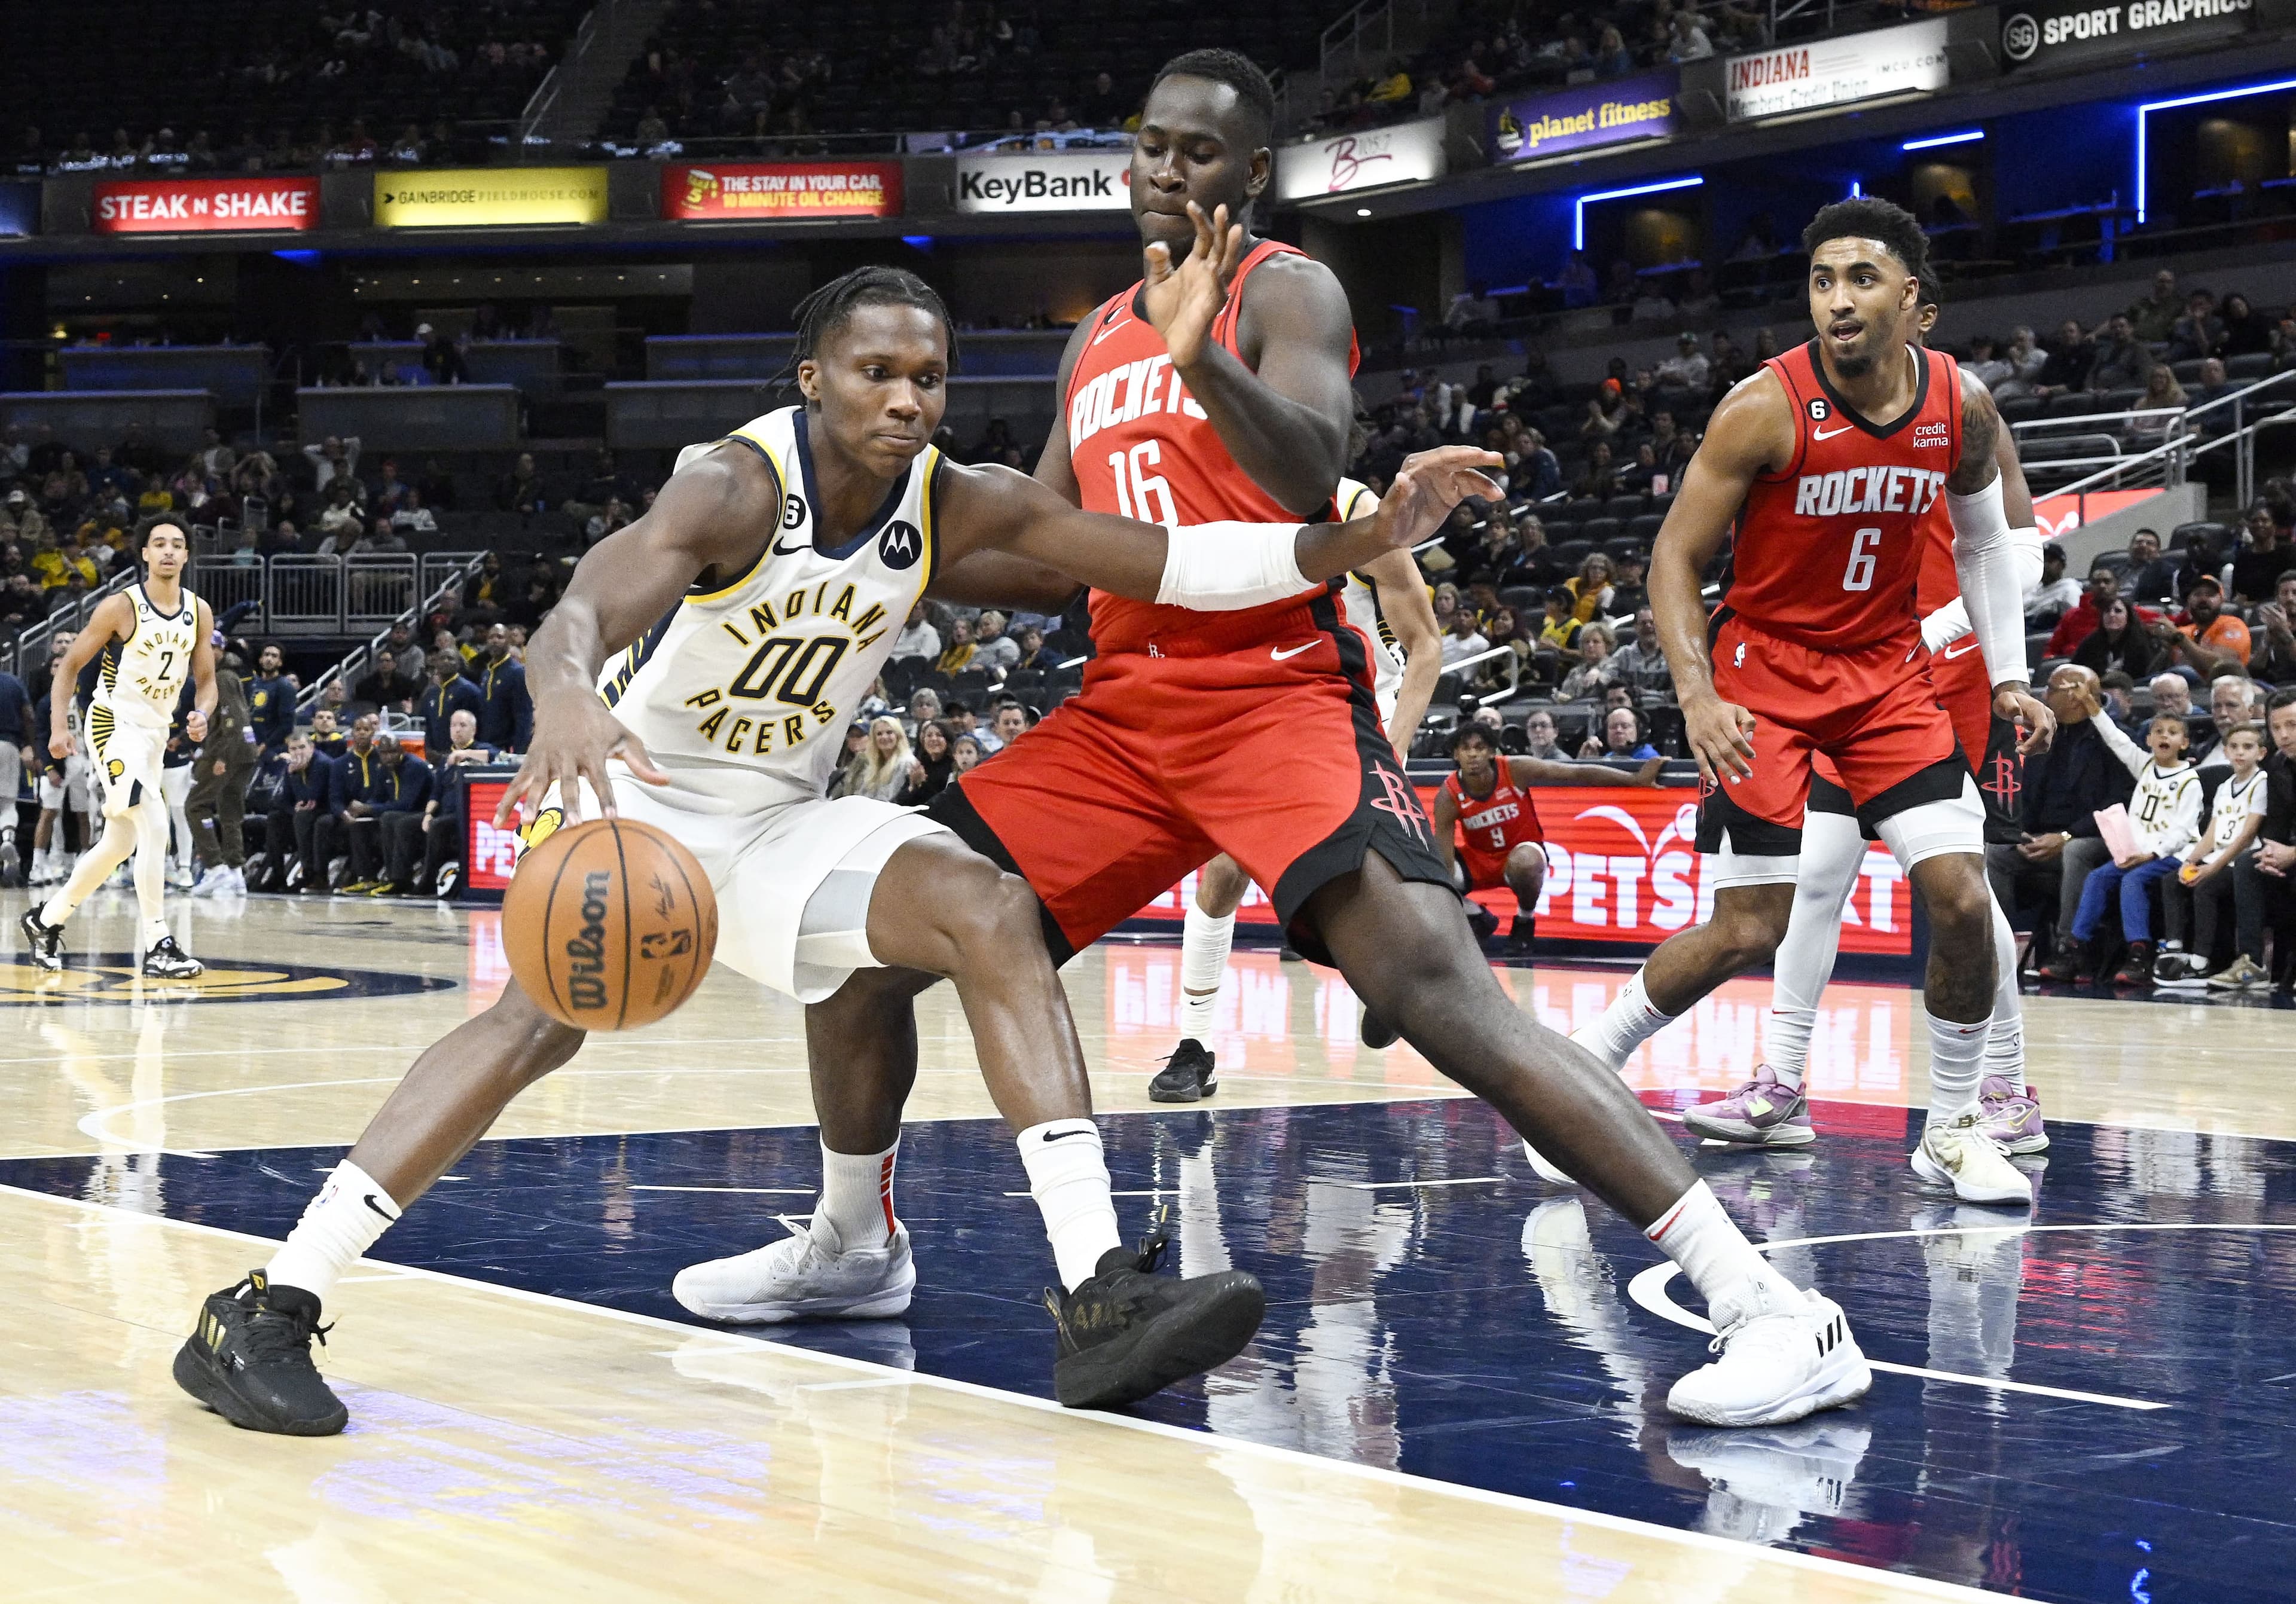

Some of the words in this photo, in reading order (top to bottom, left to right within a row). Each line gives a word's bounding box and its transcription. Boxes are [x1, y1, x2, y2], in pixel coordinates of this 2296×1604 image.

[2044, 7, 2121, 44] SPORT
[1732, 49, 1810, 90] INDIANA
[1791, 84, 1827, 109] Credit
[1832, 80, 1869, 100] Union
[1529, 109, 1596, 148] planet
[1599, 97, 1672, 128] fitness
[722, 176, 750, 191] THE
[752, 176, 789, 191] STAY
[789, 175, 806, 190] IN
[807, 175, 848, 190] YOUR
[960, 168, 1113, 204] KeyBank
[100, 194, 189, 220] STEAK
[193, 197, 209, 215] N
[213, 190, 307, 218] SHAKE
[722, 193, 738, 208] 10
[738, 191, 798, 208] MINUTE
[799, 192, 822, 207] OIL
[1811, 401, 1825, 419] 6
[1913, 436, 1949, 448] karma
[1915, 421, 1946, 435] credit
[1109, 439, 1179, 527] 16
[1795, 465, 1946, 516] ROCKETS
[783, 500, 800, 525] 6
[1843, 528, 1882, 591] 6
[721, 581, 888, 653] INDIANA
[158, 651, 173, 680] 2
[728, 635, 851, 708] 00
[136, 677, 182, 699] PACERS
[685, 687, 836, 756] PACERS
[2141, 795, 2159, 822] 0
[2222, 820, 2236, 840] 3
[566, 870, 611, 1010] Wilson
